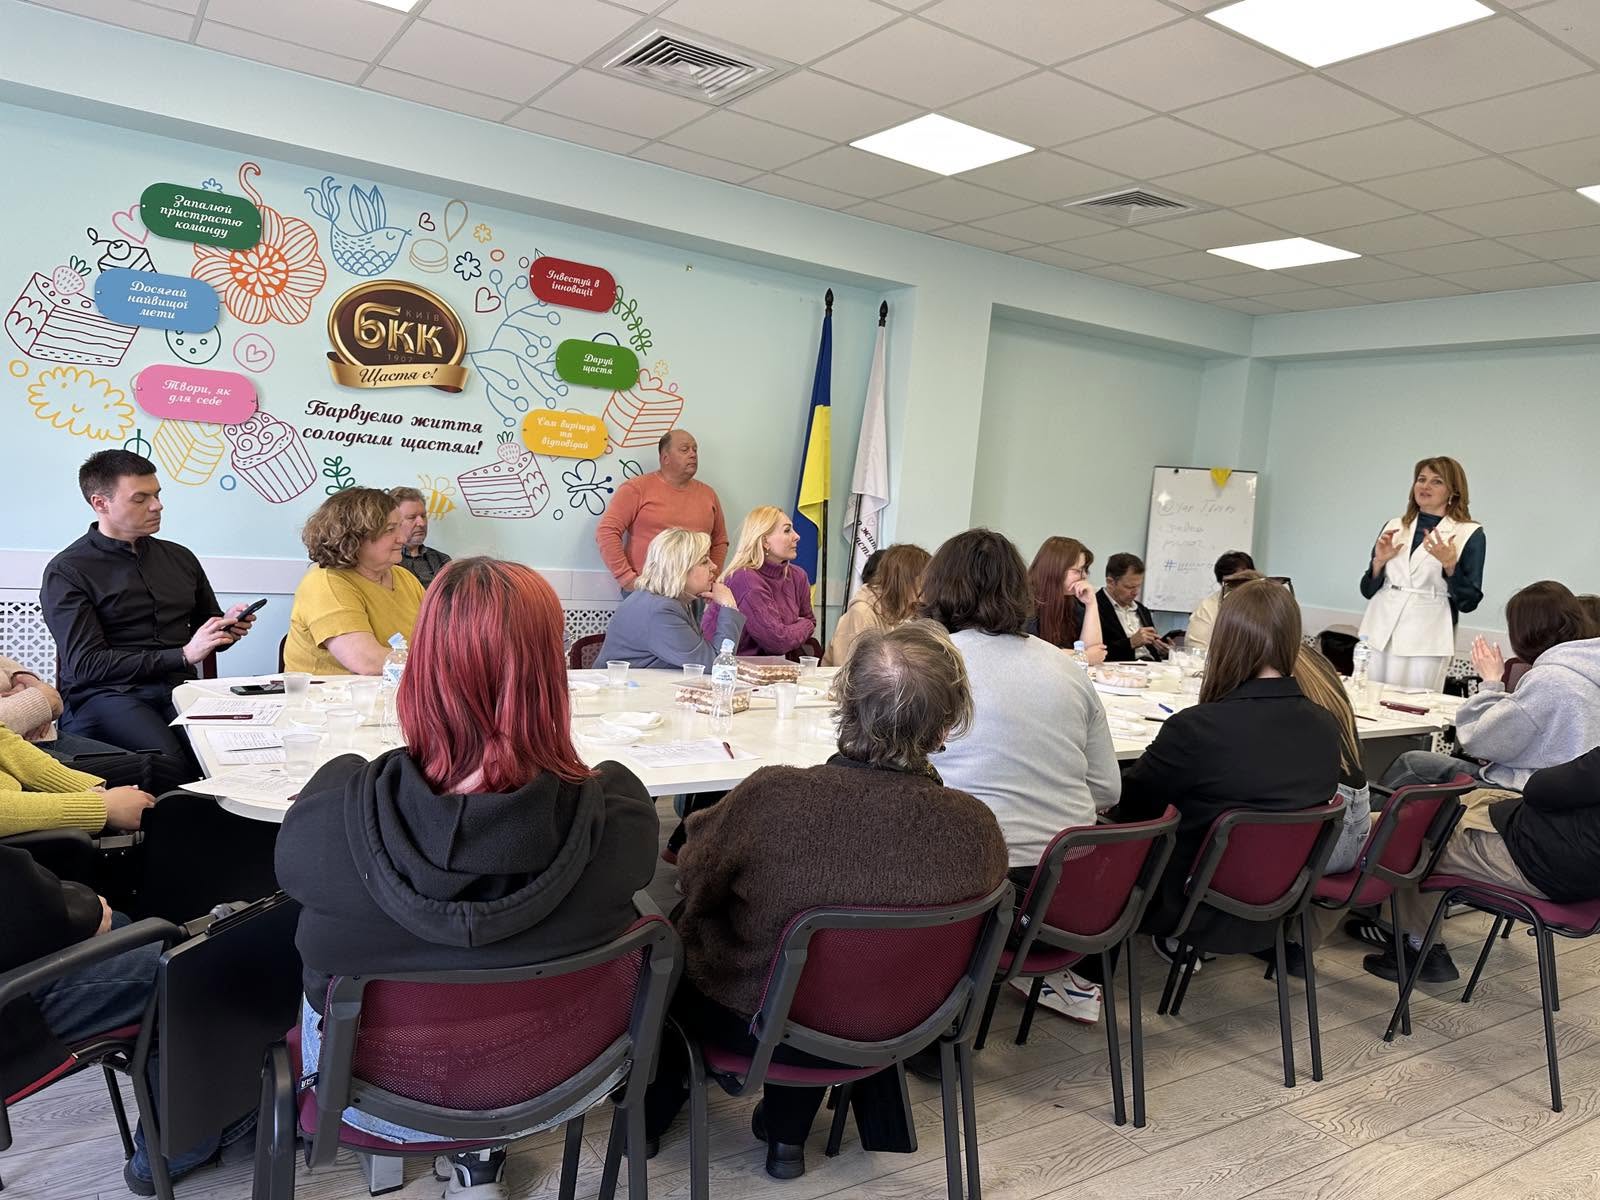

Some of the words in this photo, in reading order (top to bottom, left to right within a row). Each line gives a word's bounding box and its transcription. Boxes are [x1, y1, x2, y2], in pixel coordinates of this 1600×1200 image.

[173, 194, 232, 214] Запалюй
[159, 205, 244, 228] пристрастю
[174, 219, 229, 239] команду
[546, 269, 592, 288] Інвестуй
[593, 277, 600, 288] в
[129, 280, 188, 298] Досягай
[551, 281, 594, 297] інновації
[127, 294, 189, 311] найвищої
[139, 307, 177, 320] мети
[405, 309, 440, 323] КИЇВ
[583, 353, 614, 367] Даруй
[359, 367, 419, 386] Щастя
[582, 364, 613, 376] щастя
[162, 379, 212, 396] Твори,
[215, 386, 232, 396] як
[168, 392, 191, 404] для
[196, 394, 223, 406] себе
[304, 399, 404, 425] Барвуємо
[411, 415, 483, 434] життя
[302, 425, 393, 447] солодким
[400, 436, 484, 455] щастям!
